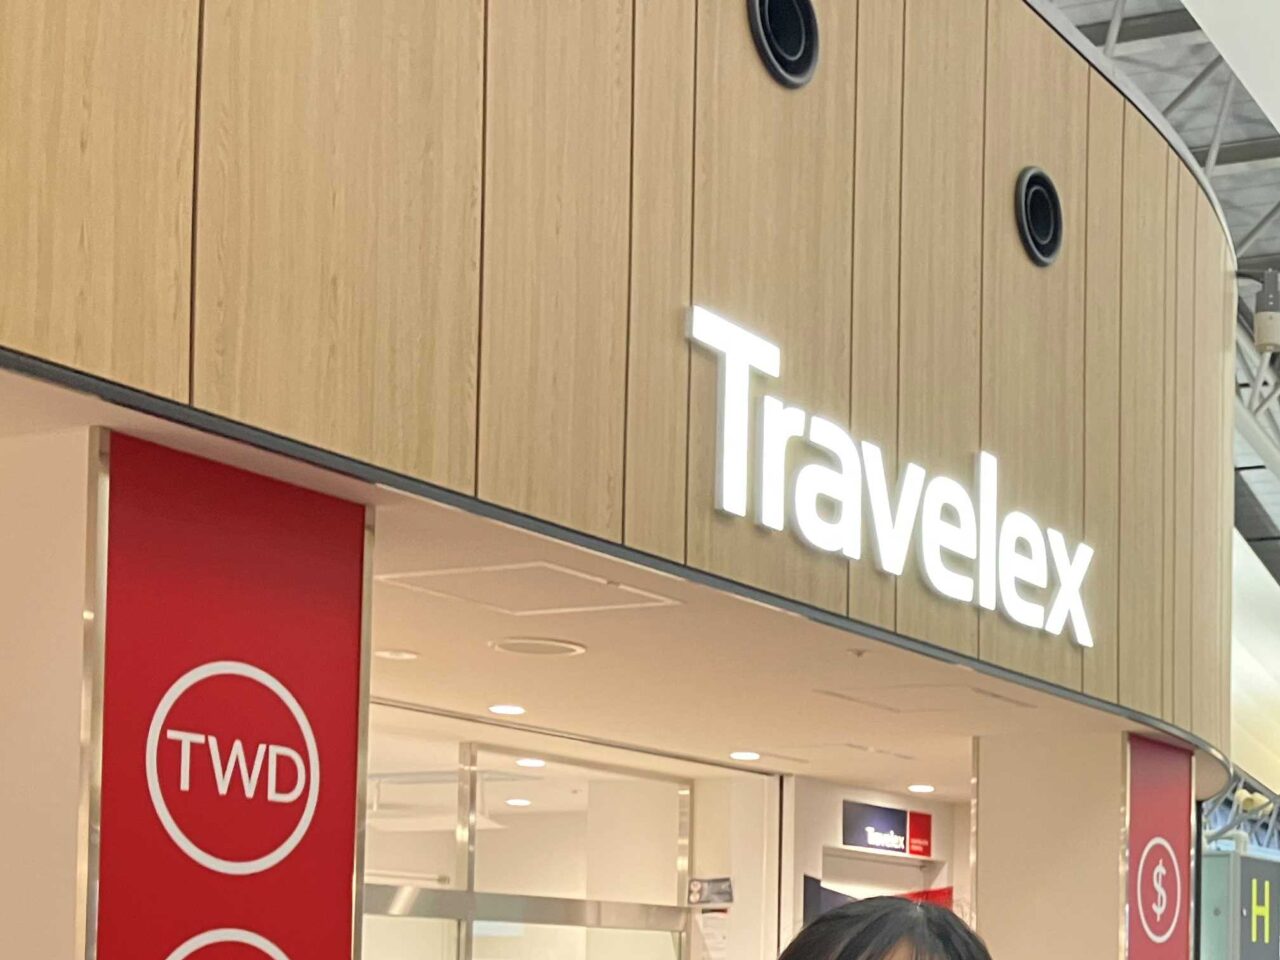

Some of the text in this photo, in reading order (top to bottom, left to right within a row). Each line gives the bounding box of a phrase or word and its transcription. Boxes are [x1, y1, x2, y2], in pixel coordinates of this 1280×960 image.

[691, 304, 1094, 648] Travelex
[166, 729, 306, 804] TWD
[1152, 858, 1167, 922] $
[1251, 878, 1270, 943] H
